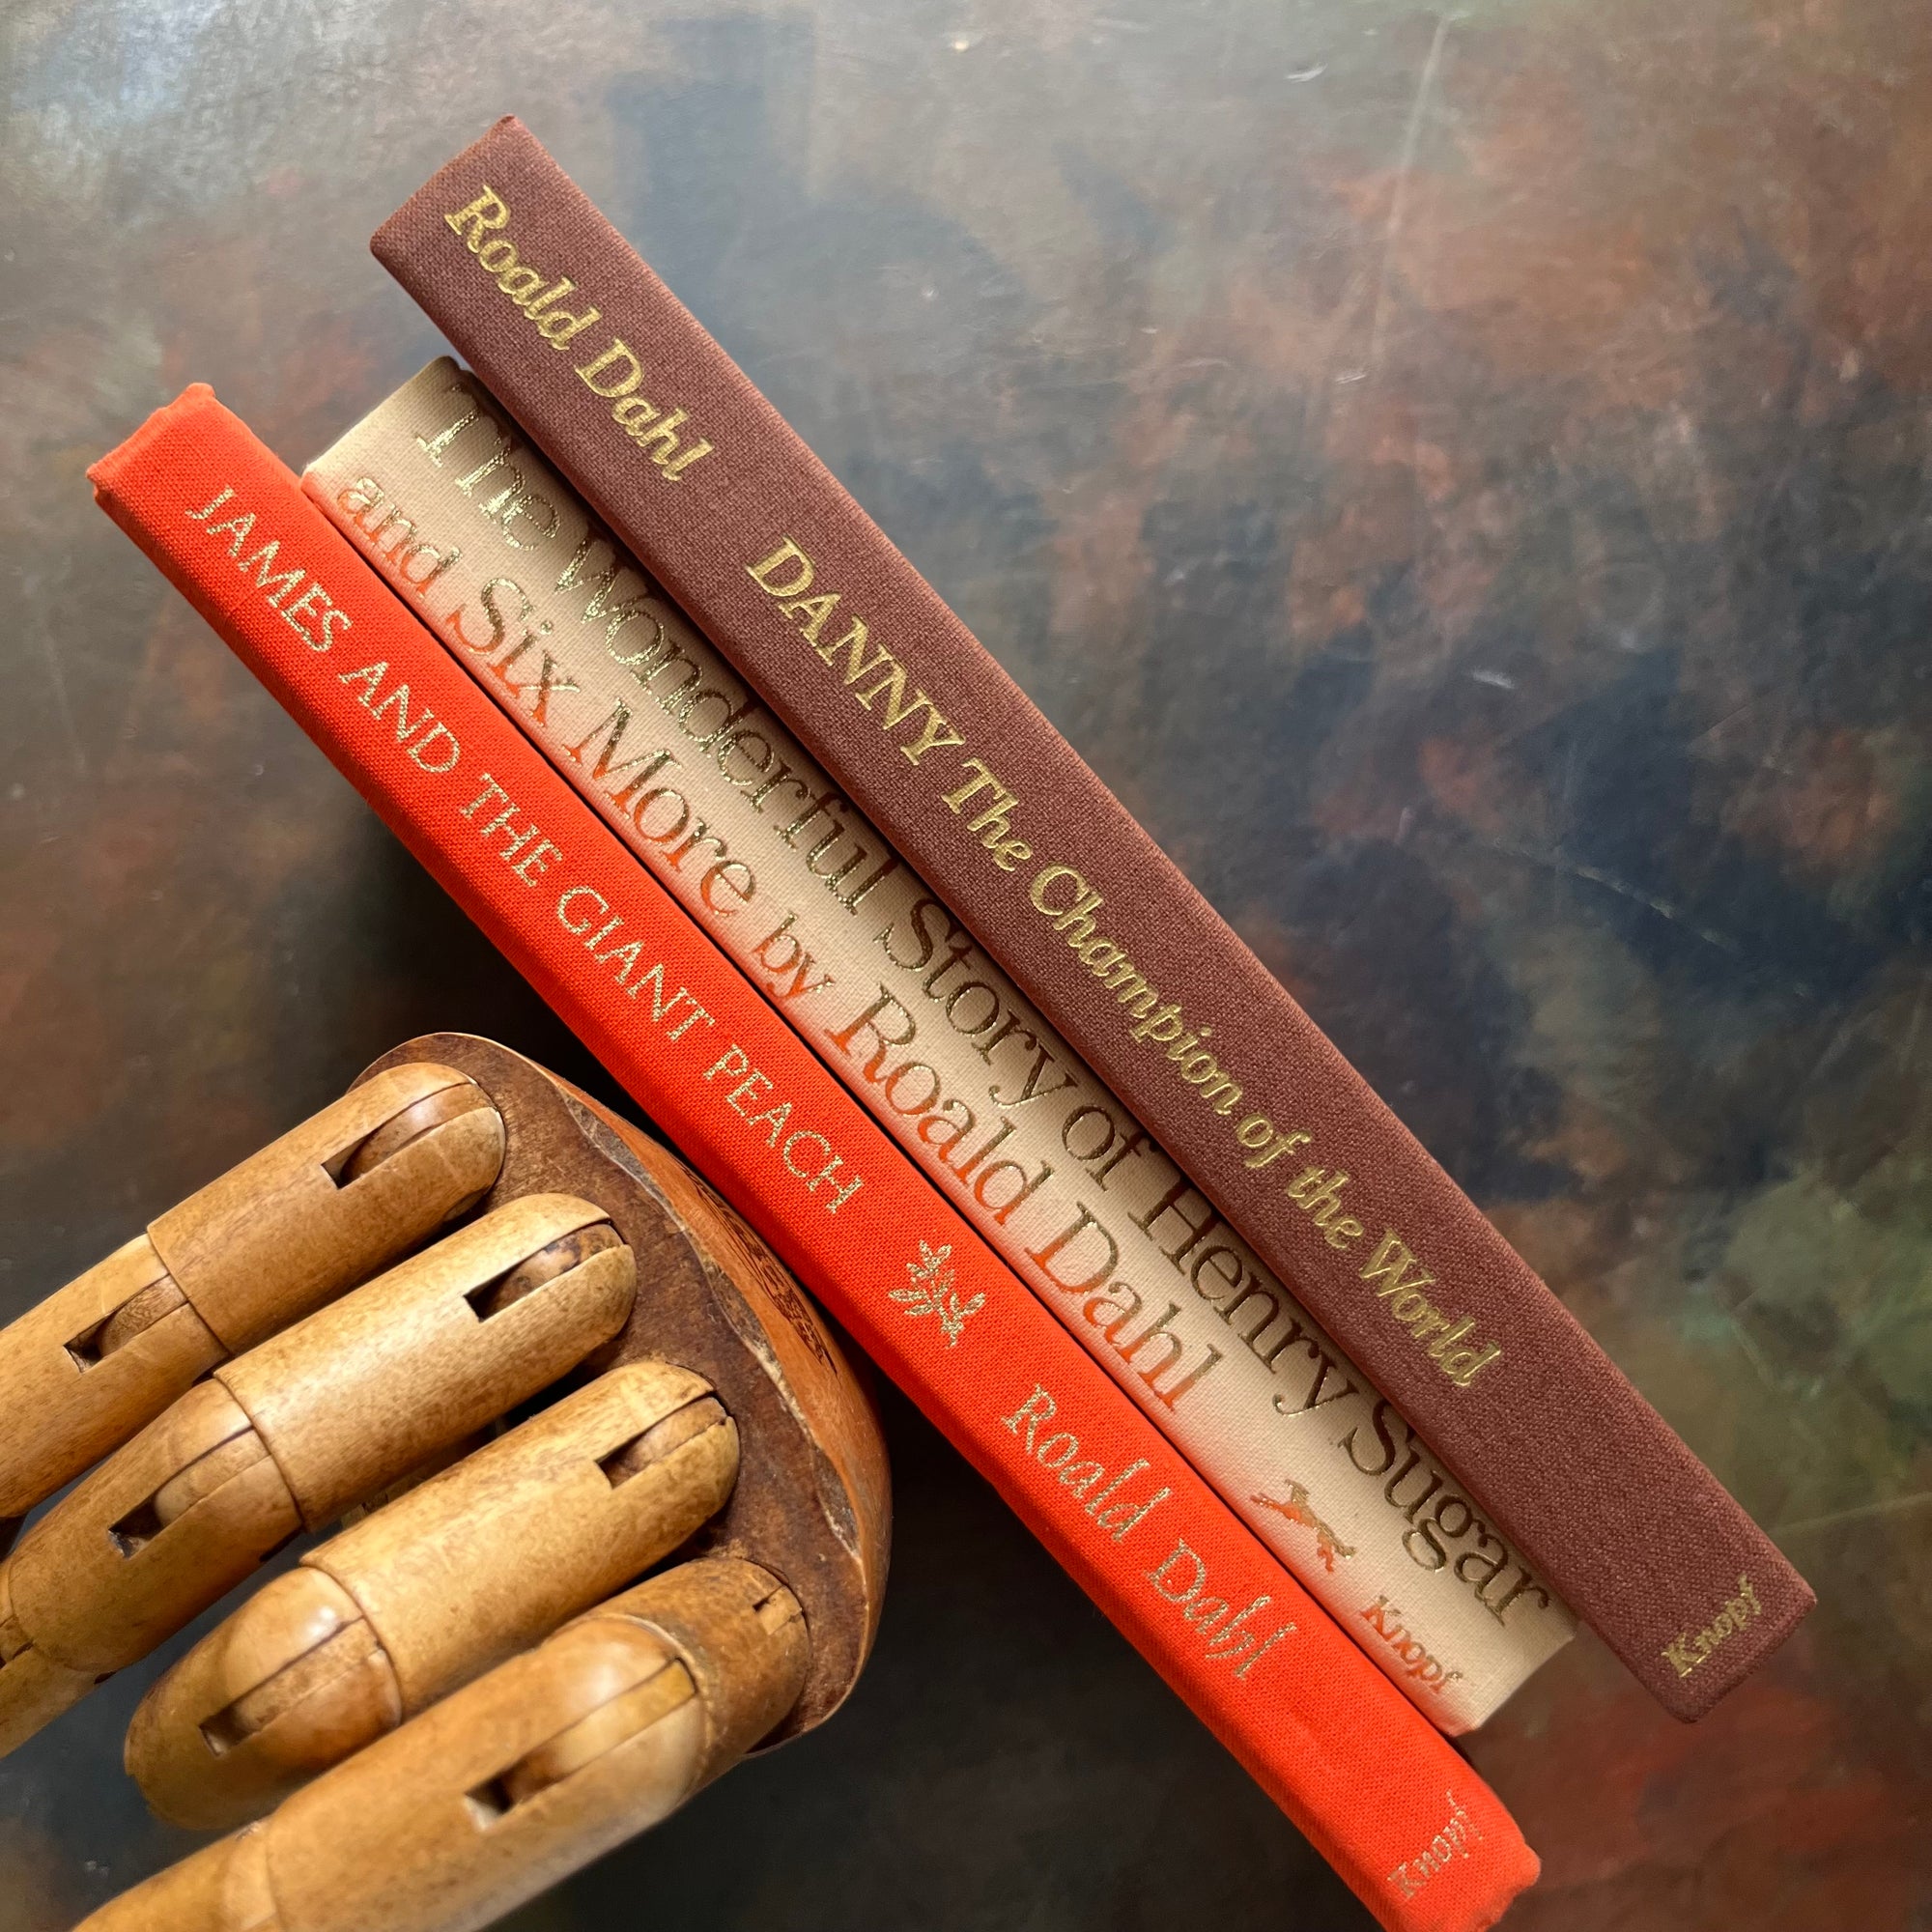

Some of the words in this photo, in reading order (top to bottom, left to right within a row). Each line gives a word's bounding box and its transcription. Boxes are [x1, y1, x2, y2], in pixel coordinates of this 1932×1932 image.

[444, 185, 601, 351] Roald
[575, 338, 715, 481] Dahl
[185, 488, 354, 652] JAMES
[338, 660, 461, 774] AND
[459, 773, 563, 889] THE
[555, 885, 716, 1041] GIANT
[702, 1042, 865, 1214] PEACH
[336, 476, 464, 599] and
[447, 578, 580, 728] Six
[562, 697, 755, 918] More
[752, 914, 835, 999] by
[825, 983, 1054, 1226] Roald
[1025, 1202, 1223, 1412] Dahl
[745, 535, 965, 765] DANNY
[941, 757, 1034, 871] The
[1030, 863, 1243, 1116] Champion
[1235, 1112, 1311, 1168] of
[1286, 1167, 1365, 1250] the
[1359, 1226, 1501, 1387] World
[872, 898, 1077, 1109] Story
[1061, 1104, 1156, 1191] of
[1127, 1178, 1357, 1417] Henry
[1338, 1399, 1550, 1627] Sugar
[1001, 1382, 1173, 1543] Roald
[1143, 1537, 1297, 1681] Dahl
[1359, 1595, 1463, 1692] Knopf
[1661, 1574, 1762, 1678] Knopf
[1387, 1789, 1483, 1898] Knopf
